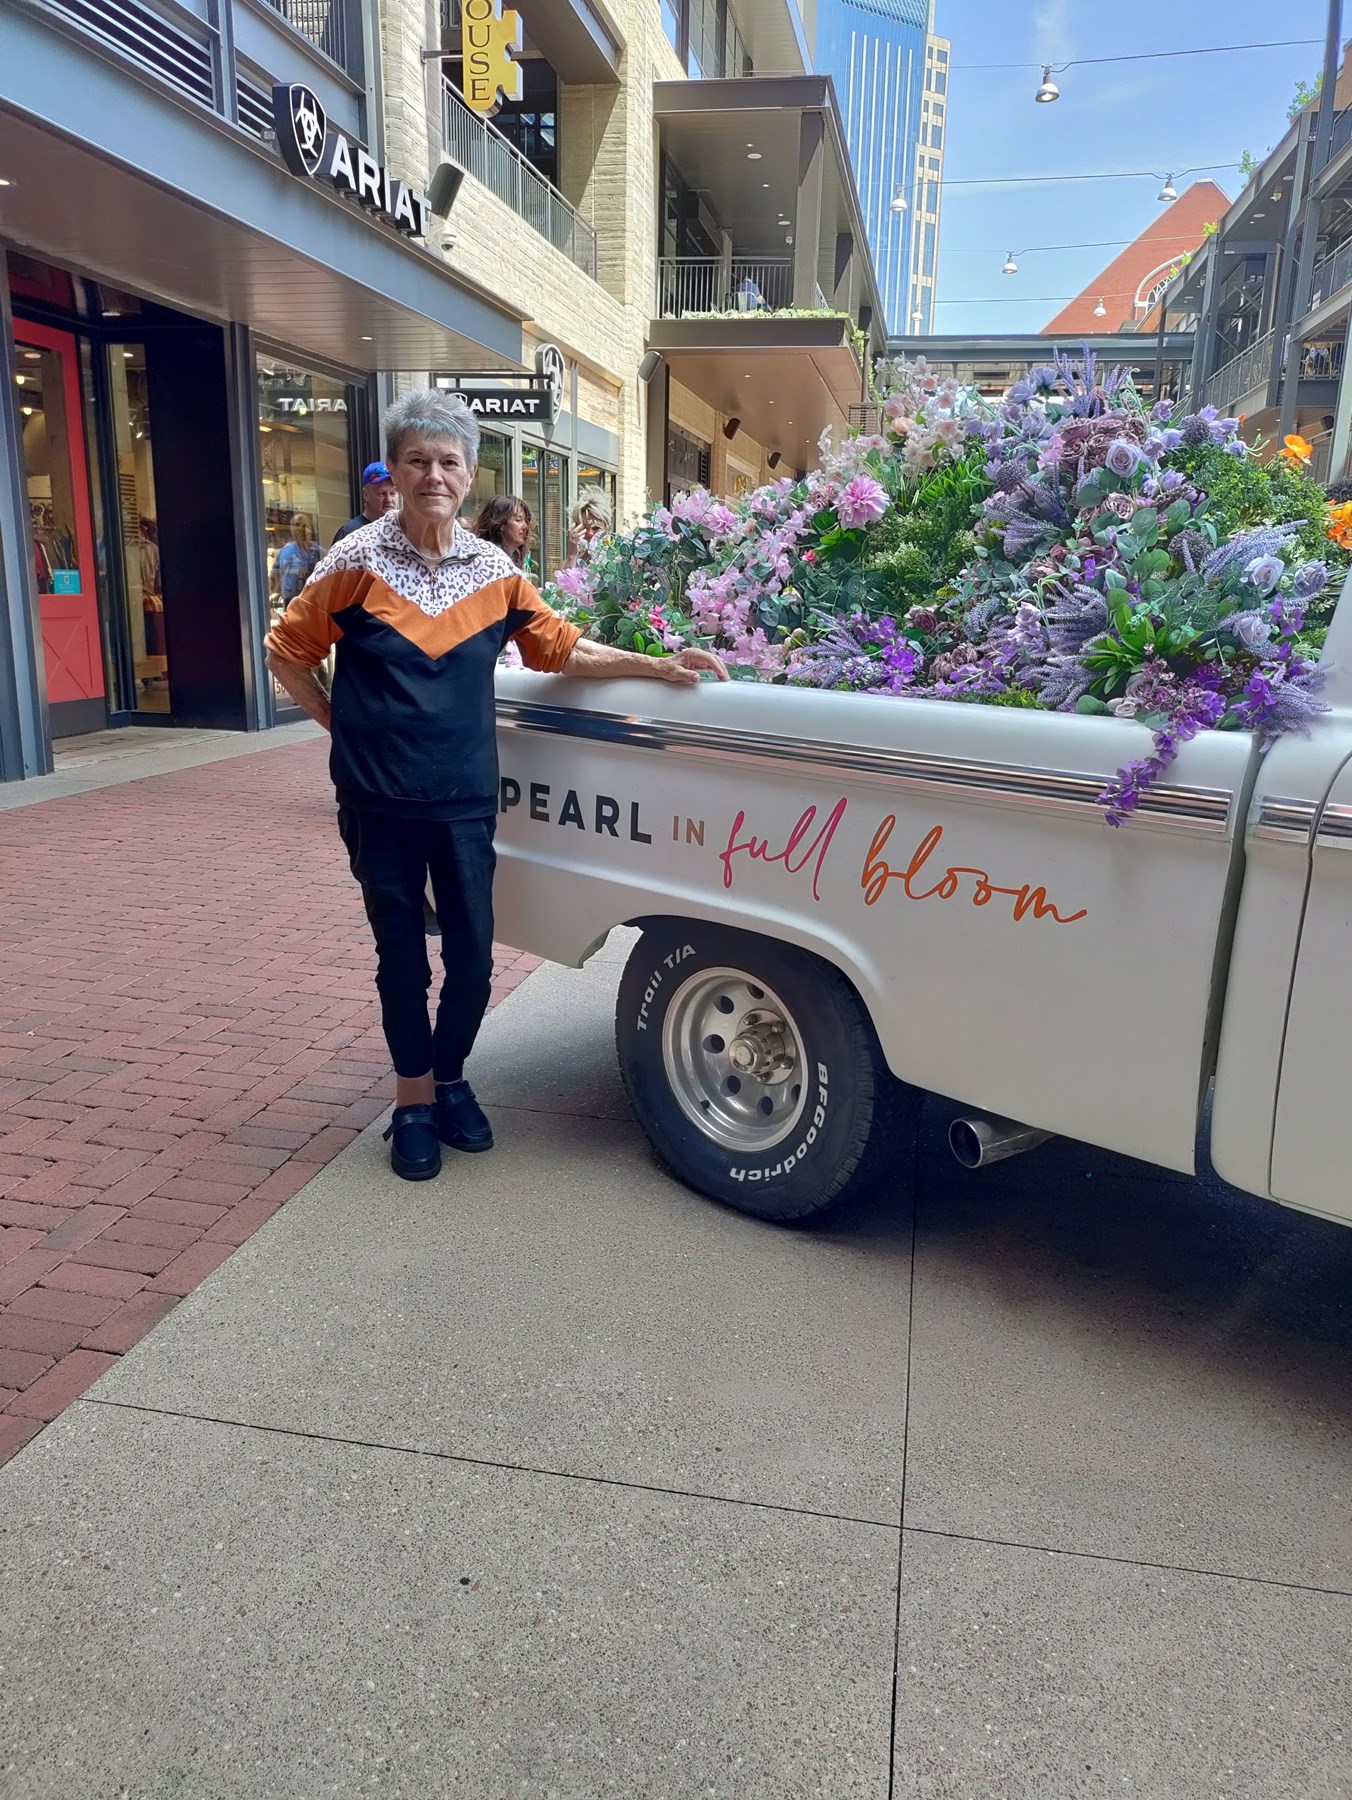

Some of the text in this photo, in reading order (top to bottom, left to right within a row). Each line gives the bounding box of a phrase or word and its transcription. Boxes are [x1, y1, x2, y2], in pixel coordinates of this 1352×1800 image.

[330, 133, 432, 236] ARIAT
[469, 398, 540, 413] ARIAT
[500, 777, 1088, 923] PEARL IN full bloom
[637, 944, 697, 1030] Trail T/A
[729, 1062, 829, 1182] BFGoodrich
